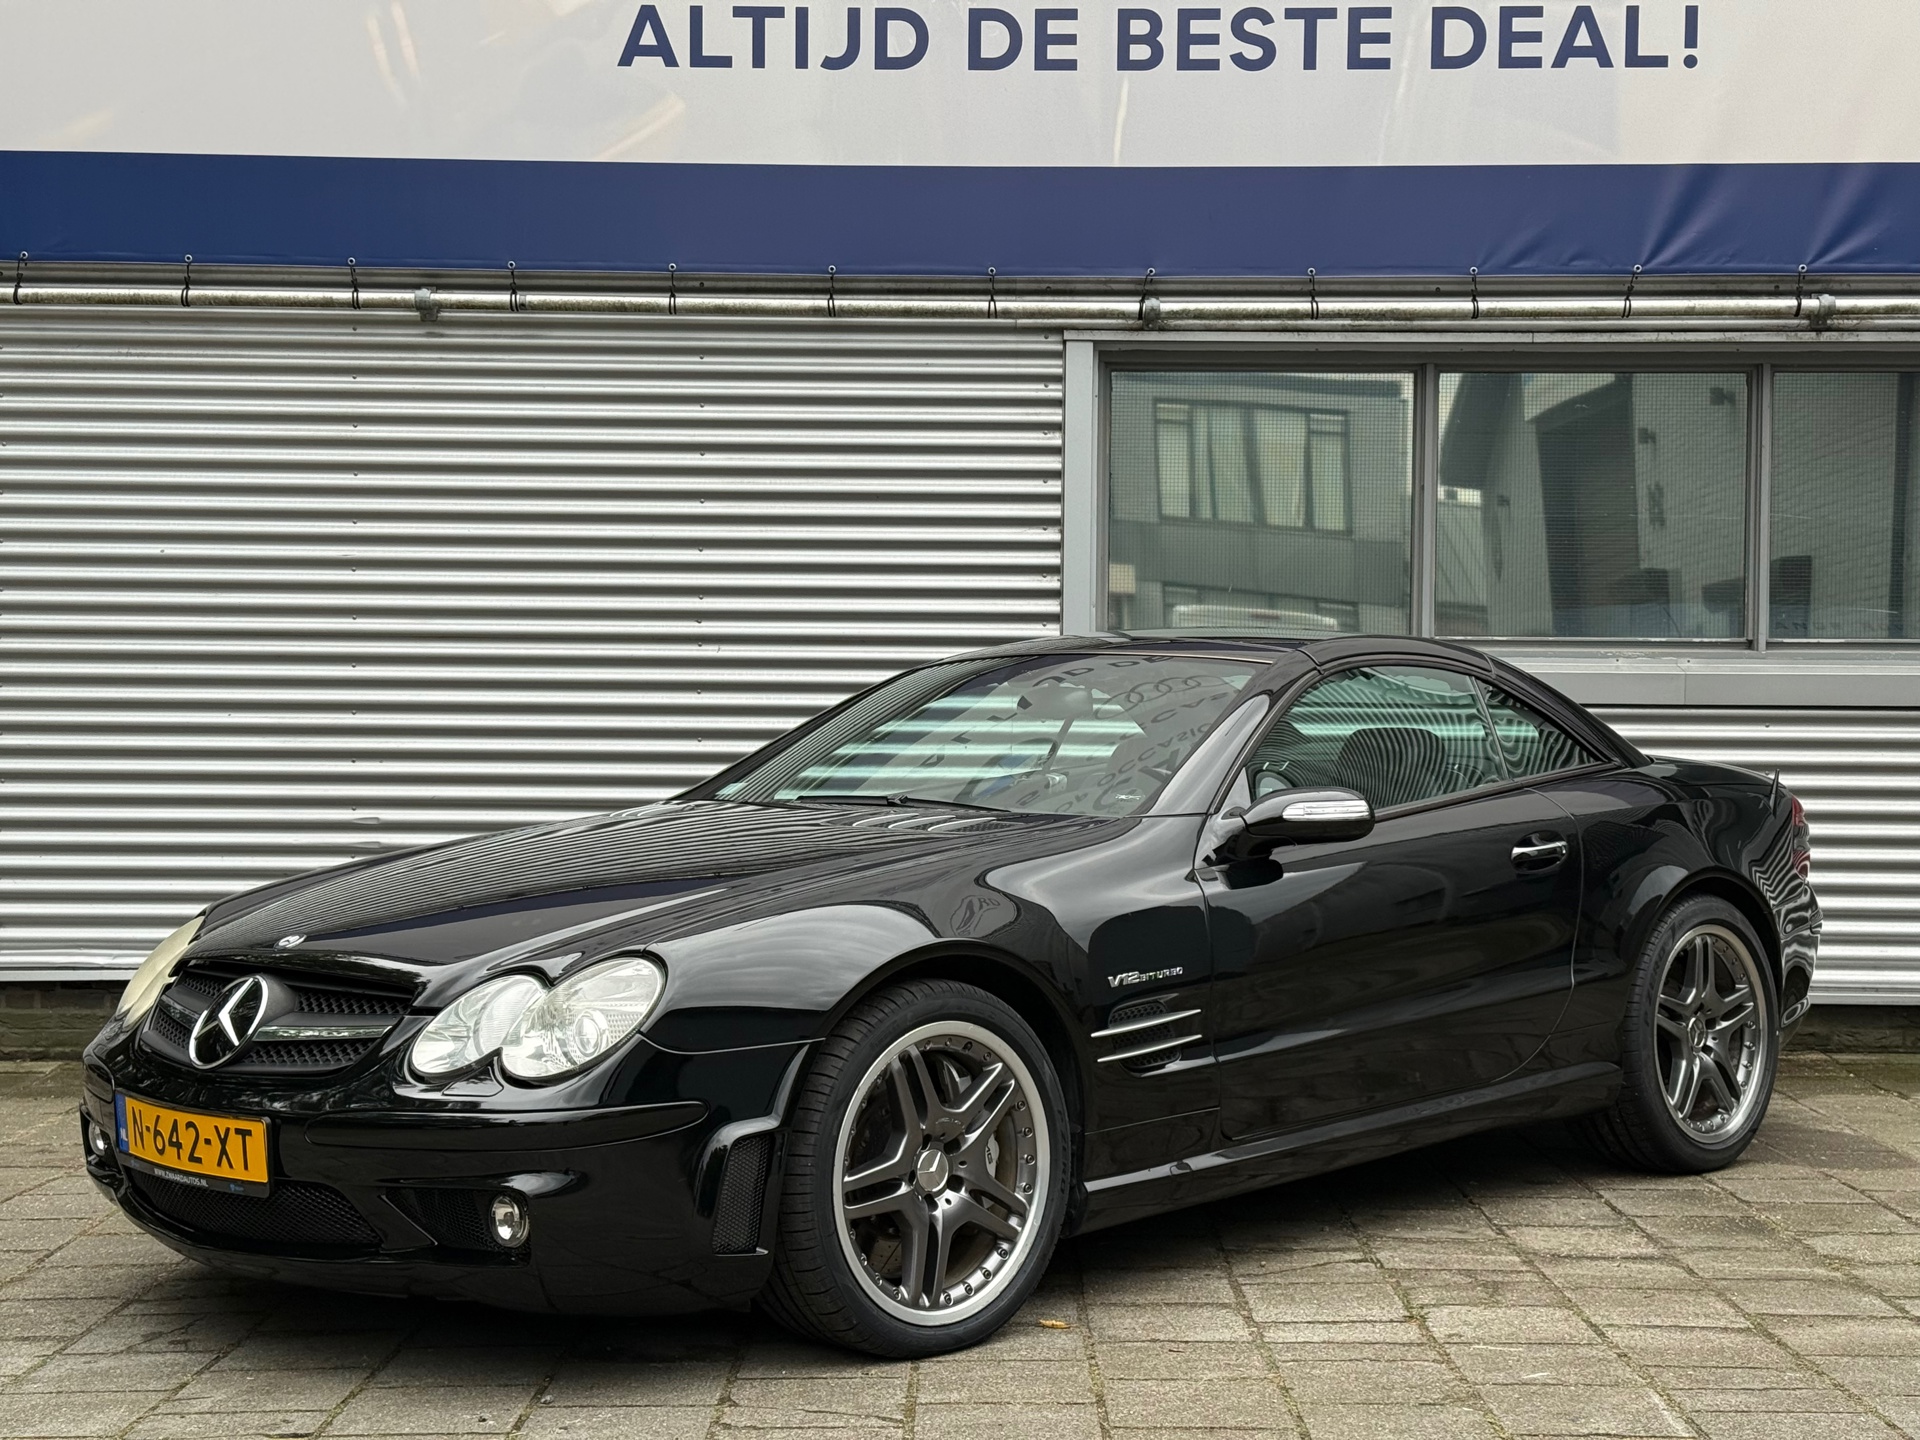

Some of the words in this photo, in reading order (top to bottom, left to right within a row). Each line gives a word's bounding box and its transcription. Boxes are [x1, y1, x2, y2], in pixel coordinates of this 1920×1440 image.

[617, 4, 929, 71] ALTIJD
[967, 6, 1078, 71] DE
[1116, 6, 1392, 71] BESTE
[1430, 4, 1698, 70] DEAL!
[131, 1105, 253, 1172] N-642-XT
